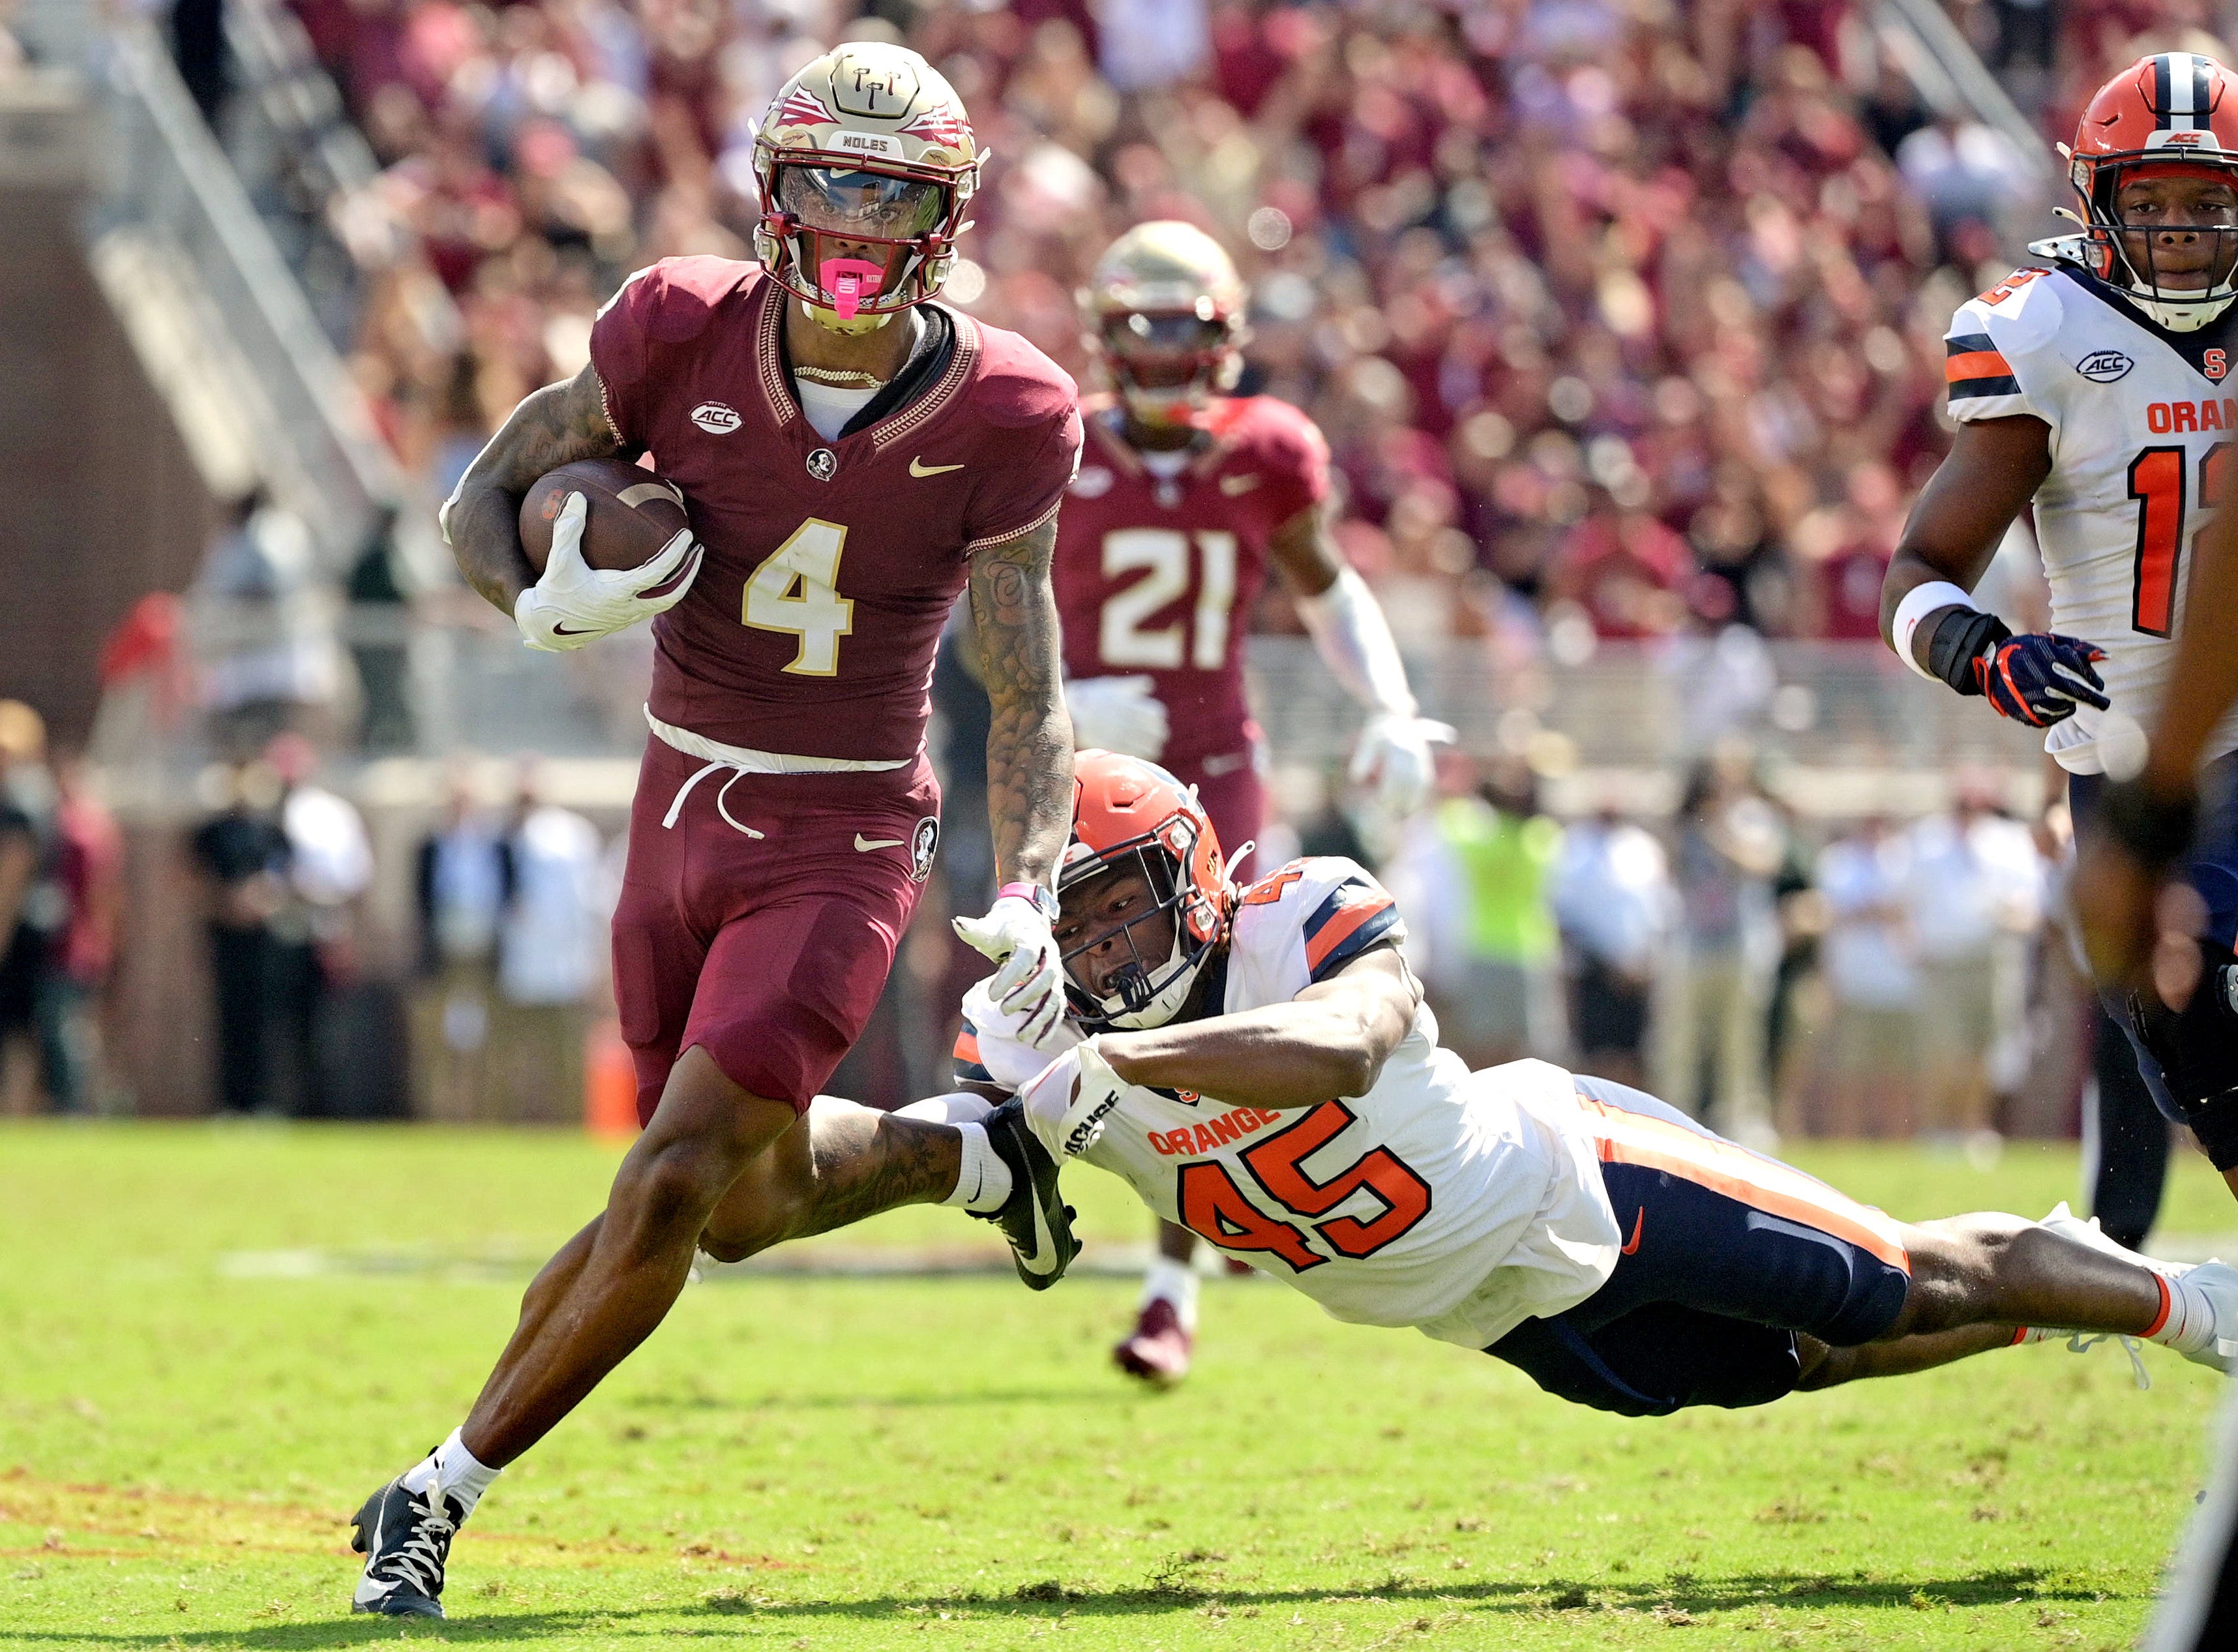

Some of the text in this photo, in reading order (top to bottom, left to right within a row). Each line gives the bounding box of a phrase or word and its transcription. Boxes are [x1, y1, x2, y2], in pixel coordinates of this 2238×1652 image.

[843, 136, 888, 152] NOLES
[2166, 132, 2201, 143] ACC
[2086, 355, 2125, 371] ACC
[2203, 348, 2226, 379] S
[697, 410, 736, 425] ACC
[741, 517, 854, 676] 4
[1100, 526, 1237, 670] 21
[1148, 1107, 1281, 1156] ORANGE
[1177, 1098, 1432, 1274] 45
